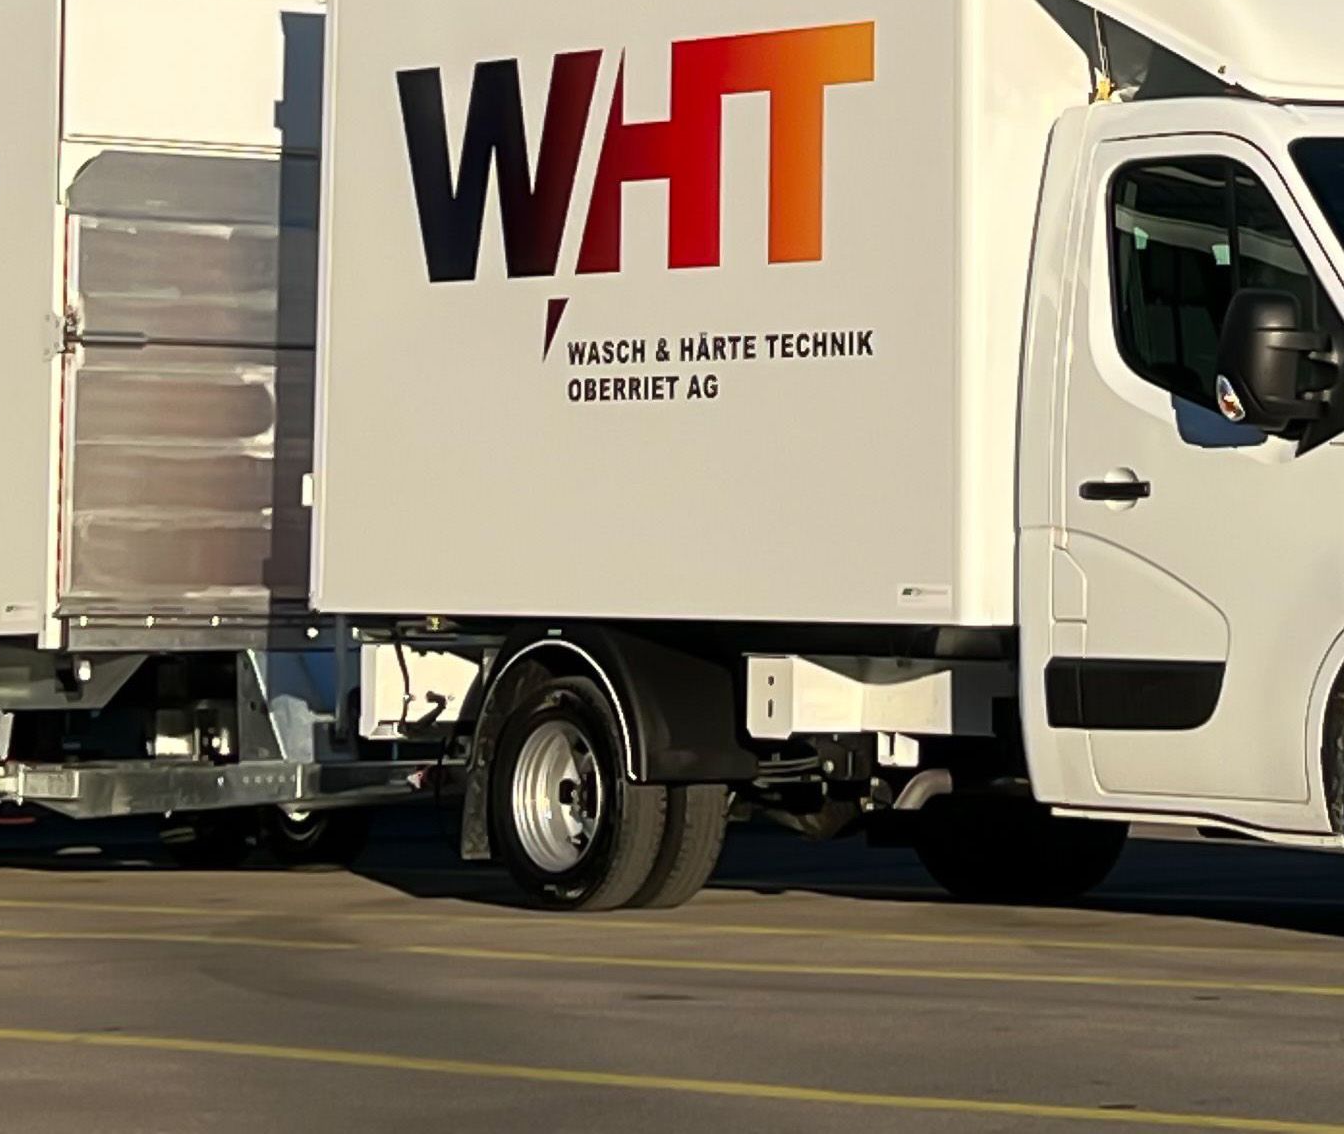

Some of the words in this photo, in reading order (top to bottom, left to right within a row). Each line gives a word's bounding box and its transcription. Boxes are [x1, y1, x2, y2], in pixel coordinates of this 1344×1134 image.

[396, 20, 875, 283] WHT
[568, 340, 645, 366] WASCH
[656, 337, 670, 362] &
[680, 332, 756, 361] HÄRTE
[766, 330, 874, 358] TECHNIK
[568, 376, 679, 402] OBERRIET
[687, 374, 719, 400] AG
